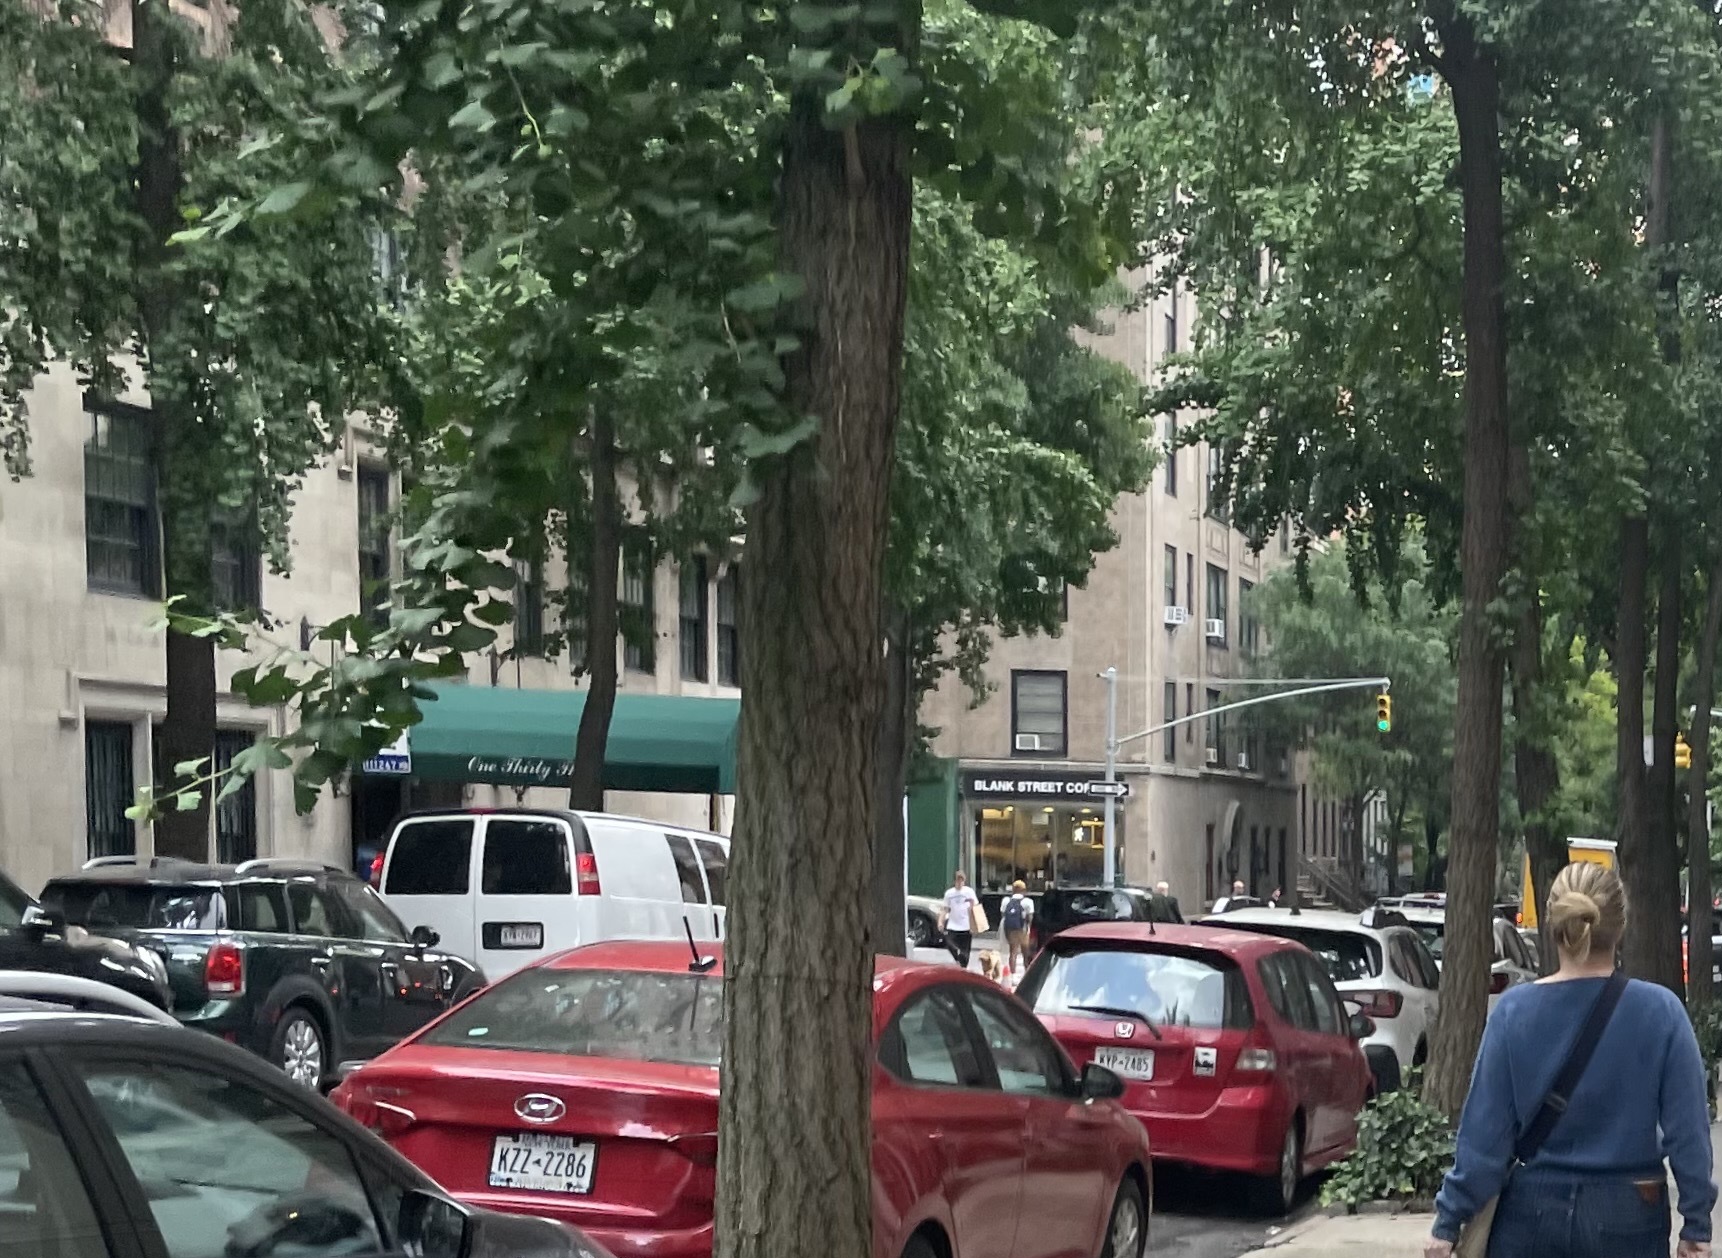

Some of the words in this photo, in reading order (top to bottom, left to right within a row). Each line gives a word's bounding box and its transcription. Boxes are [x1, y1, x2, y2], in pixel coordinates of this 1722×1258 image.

[467, 756, 497, 773] One
[501, 757, 551, 781] Thirty
[974, 780, 1014, 792] BLANK
[1018, 781, 1064, 793] STREET
[1066, 782, 1089, 794] COF
